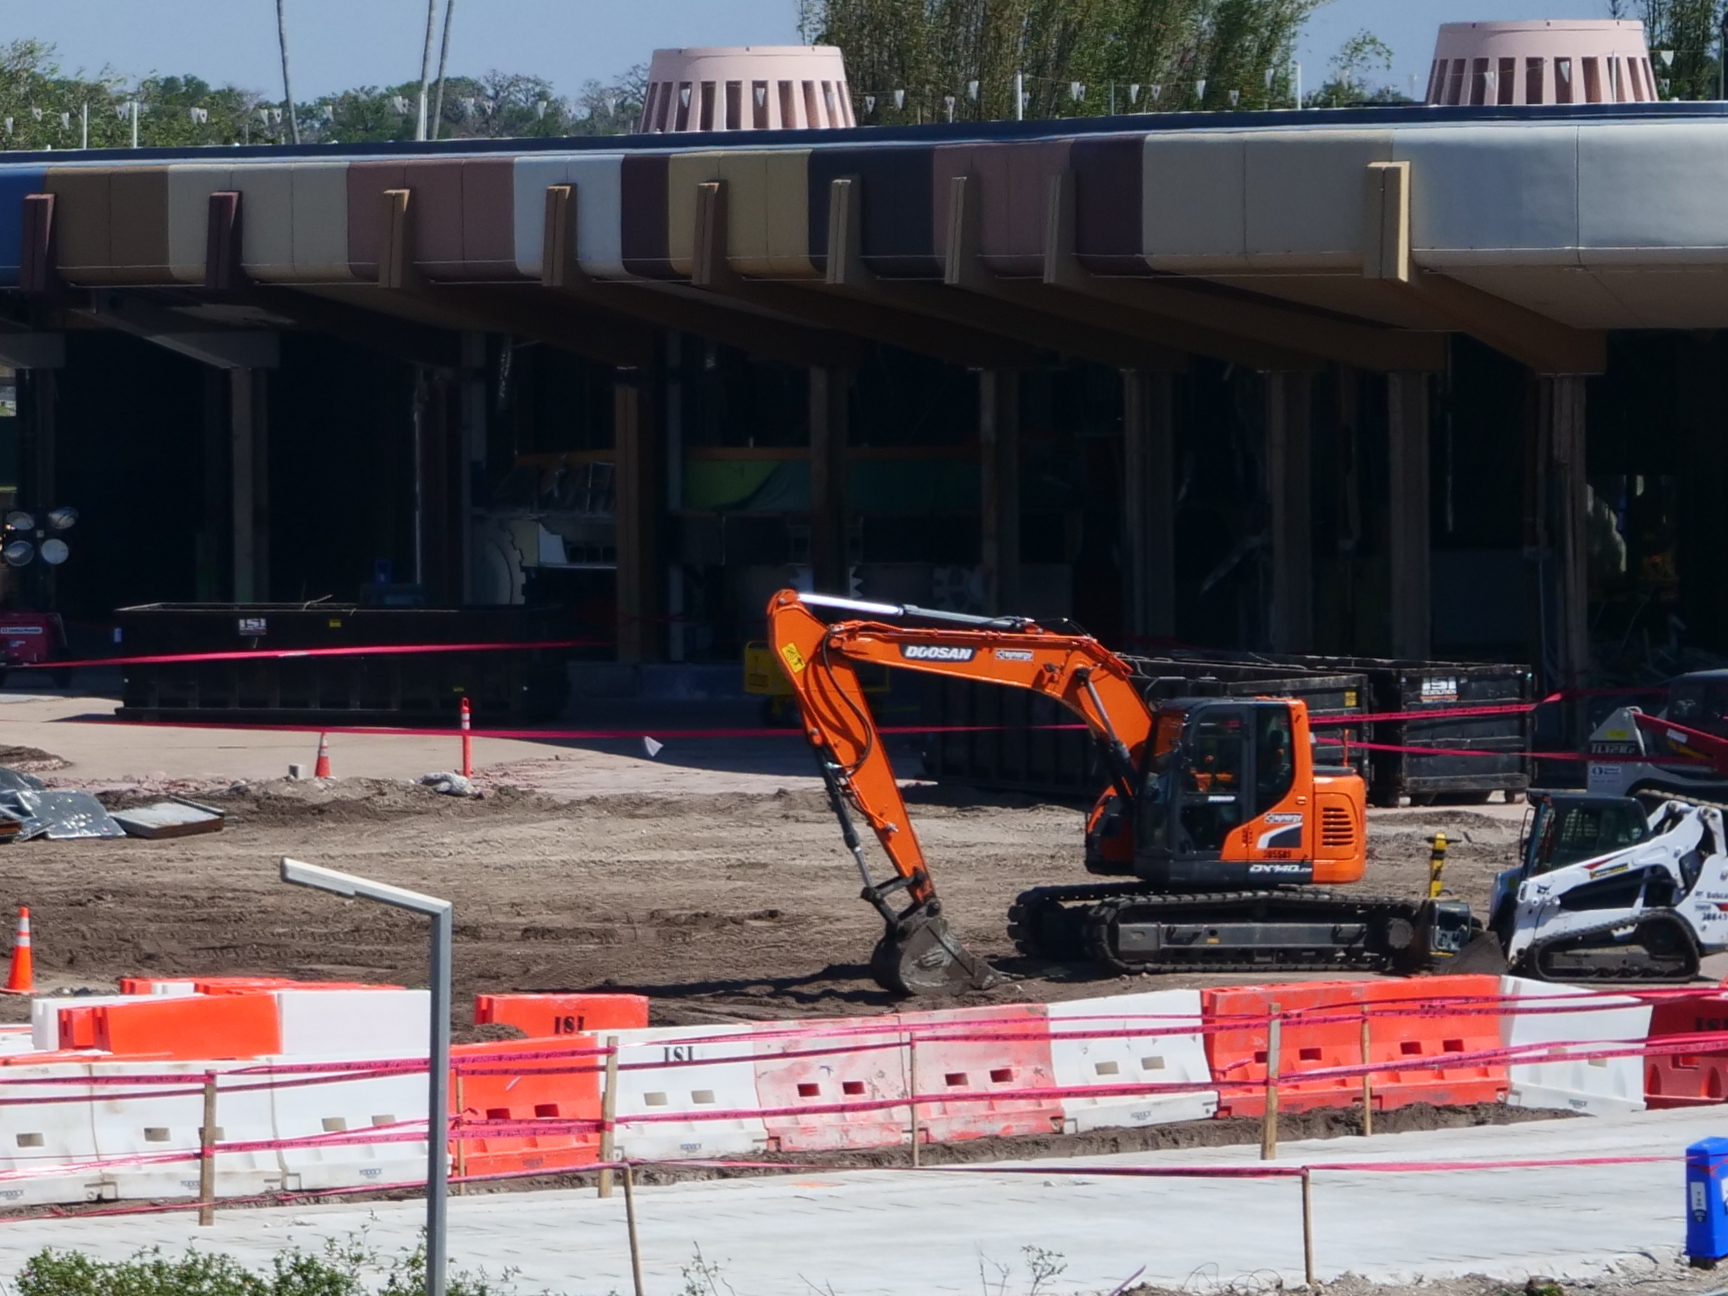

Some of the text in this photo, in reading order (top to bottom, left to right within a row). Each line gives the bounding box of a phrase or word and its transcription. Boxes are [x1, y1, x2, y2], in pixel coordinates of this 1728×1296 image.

[904, 646, 973, 660] DOOSAN
[554, 1016, 585, 1034] ISI
[663, 1046, 695, 1062] ISI
